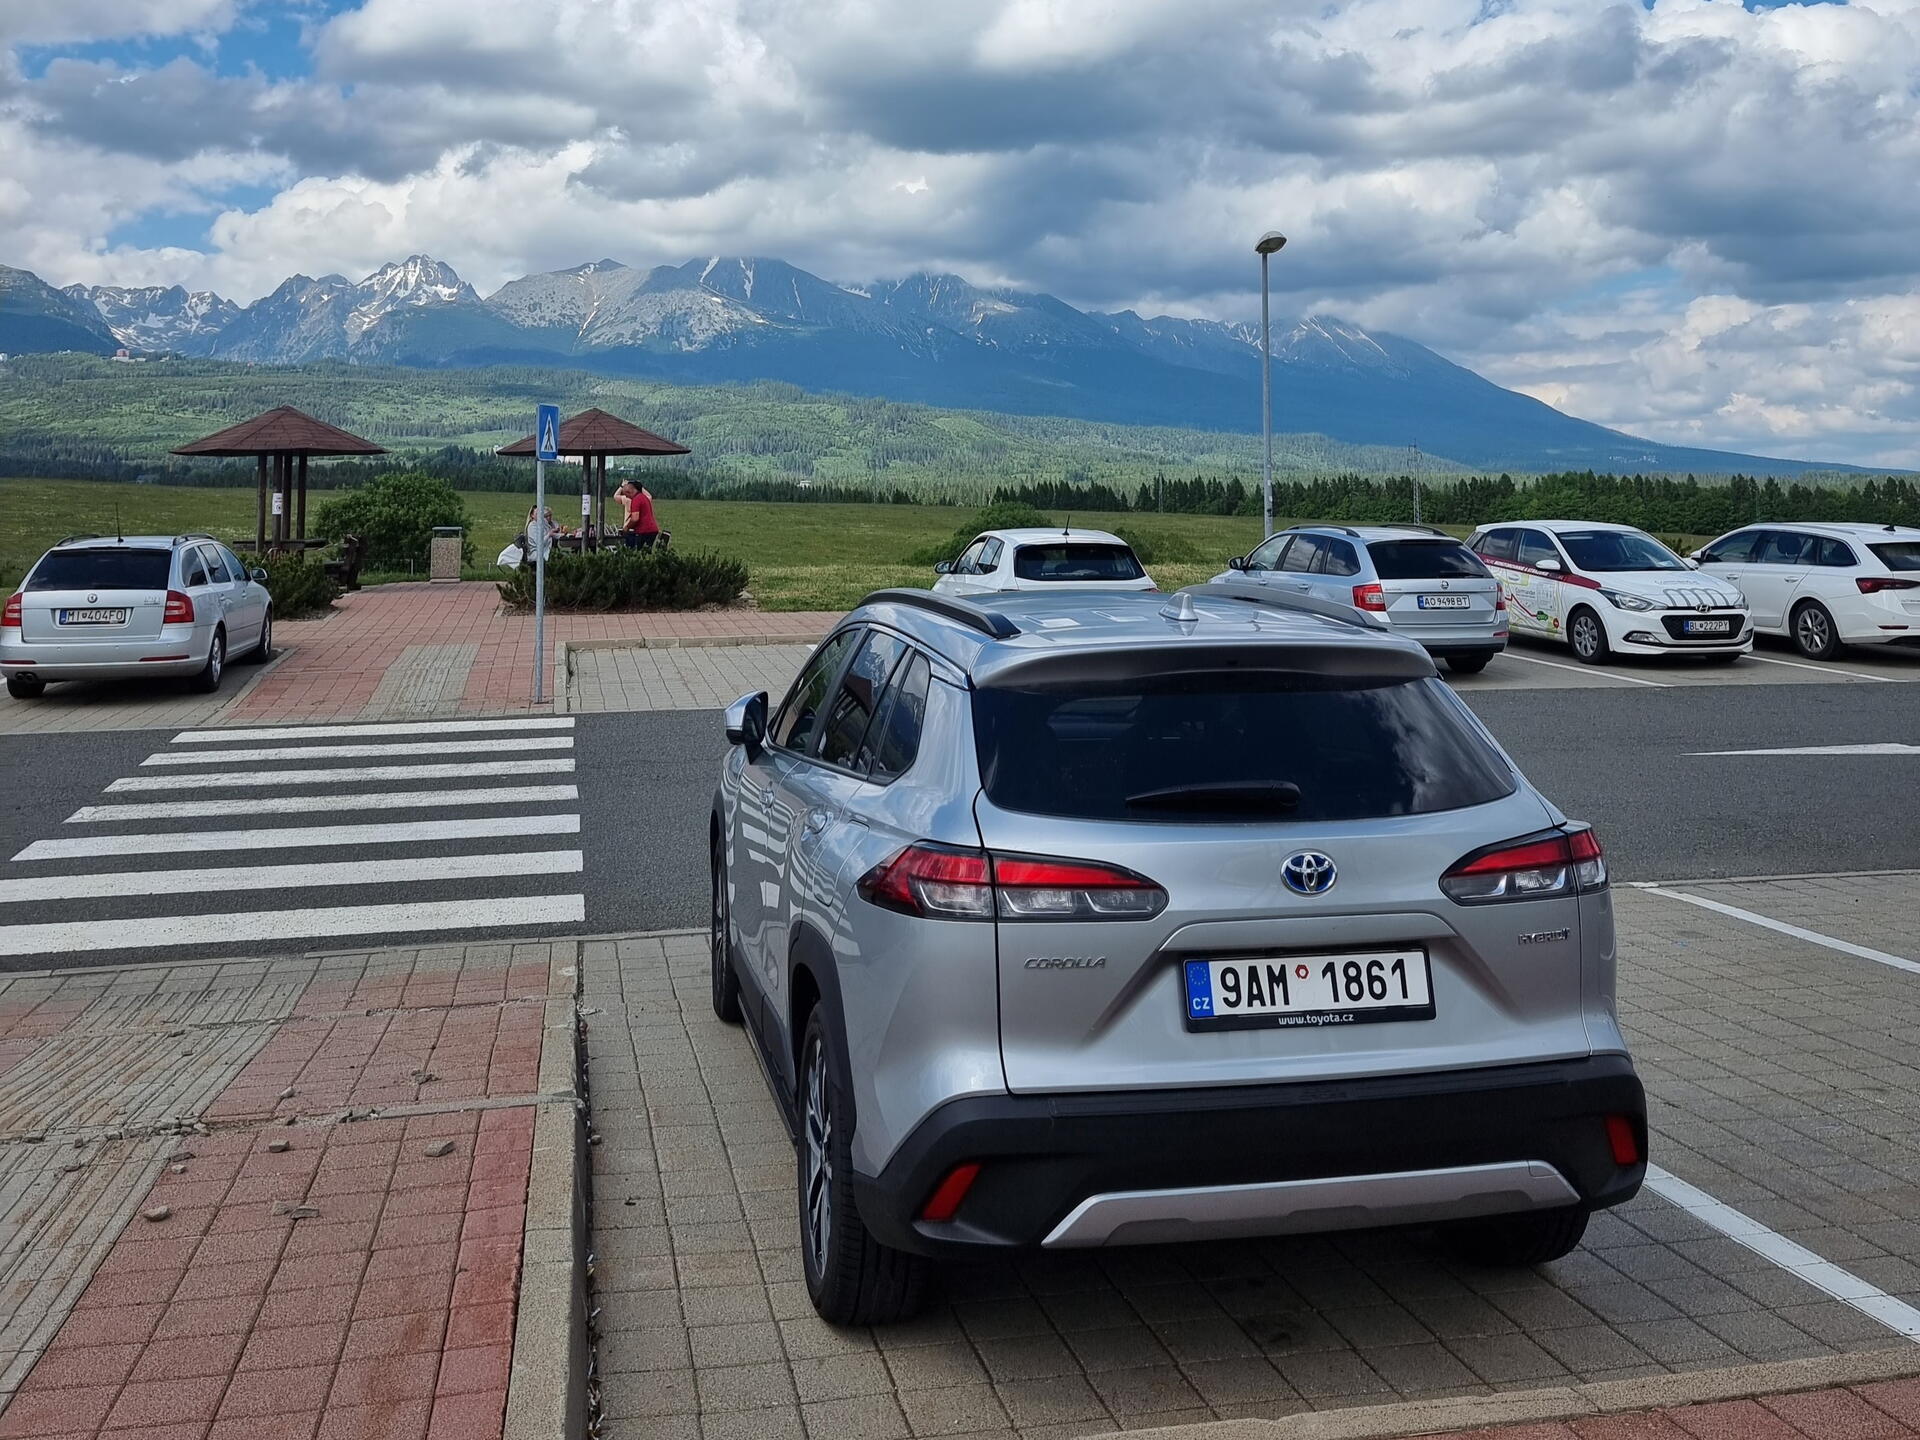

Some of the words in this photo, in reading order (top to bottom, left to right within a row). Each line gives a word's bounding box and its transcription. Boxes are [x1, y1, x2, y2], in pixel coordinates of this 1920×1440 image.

[1024, 956, 1106, 969] COROLLA
[1192, 997, 1211, 1010] CZ
[1220, 963, 1291, 1009] 9AM
[1321, 958, 1409, 1003] 1861
[1278, 1013, 1355, 1027] www.toyota.cz
